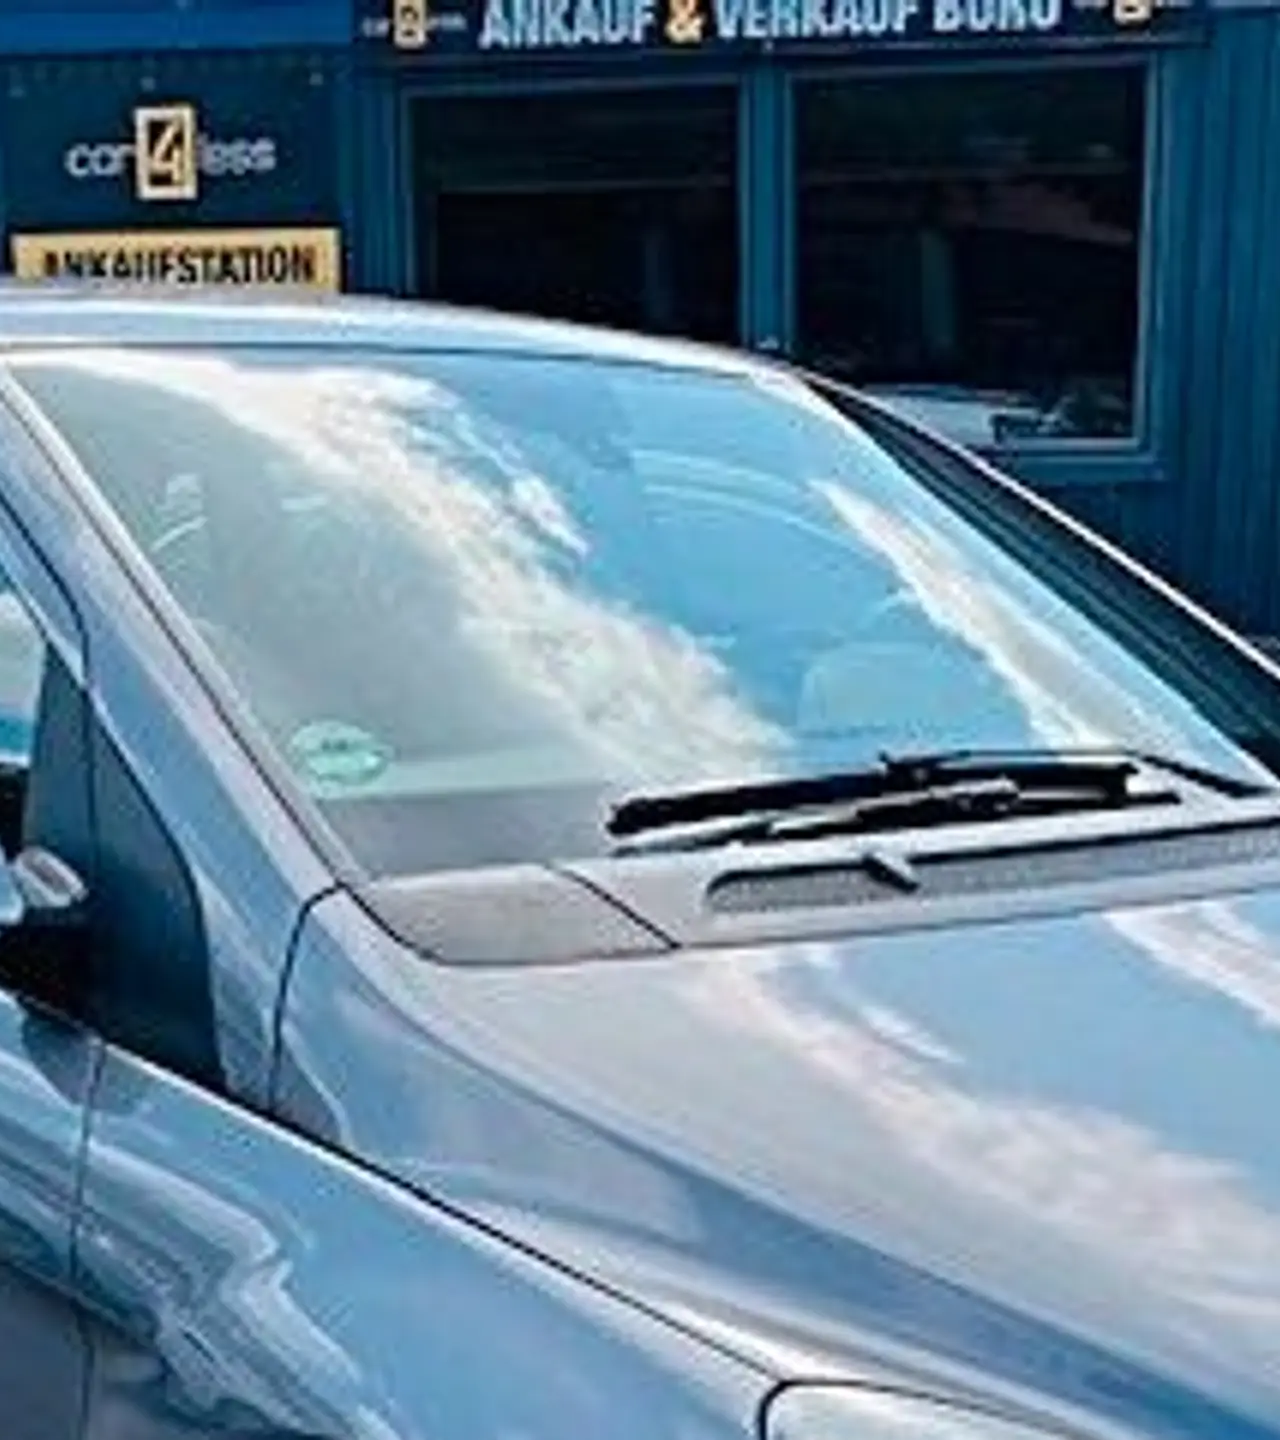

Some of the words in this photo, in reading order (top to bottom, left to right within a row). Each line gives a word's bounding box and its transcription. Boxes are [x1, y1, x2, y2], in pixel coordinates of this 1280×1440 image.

[478, 0, 654, 48] ANKAUF
[664, 0, 706, 42] &
[714, 0, 919, 38] VERKAUF
